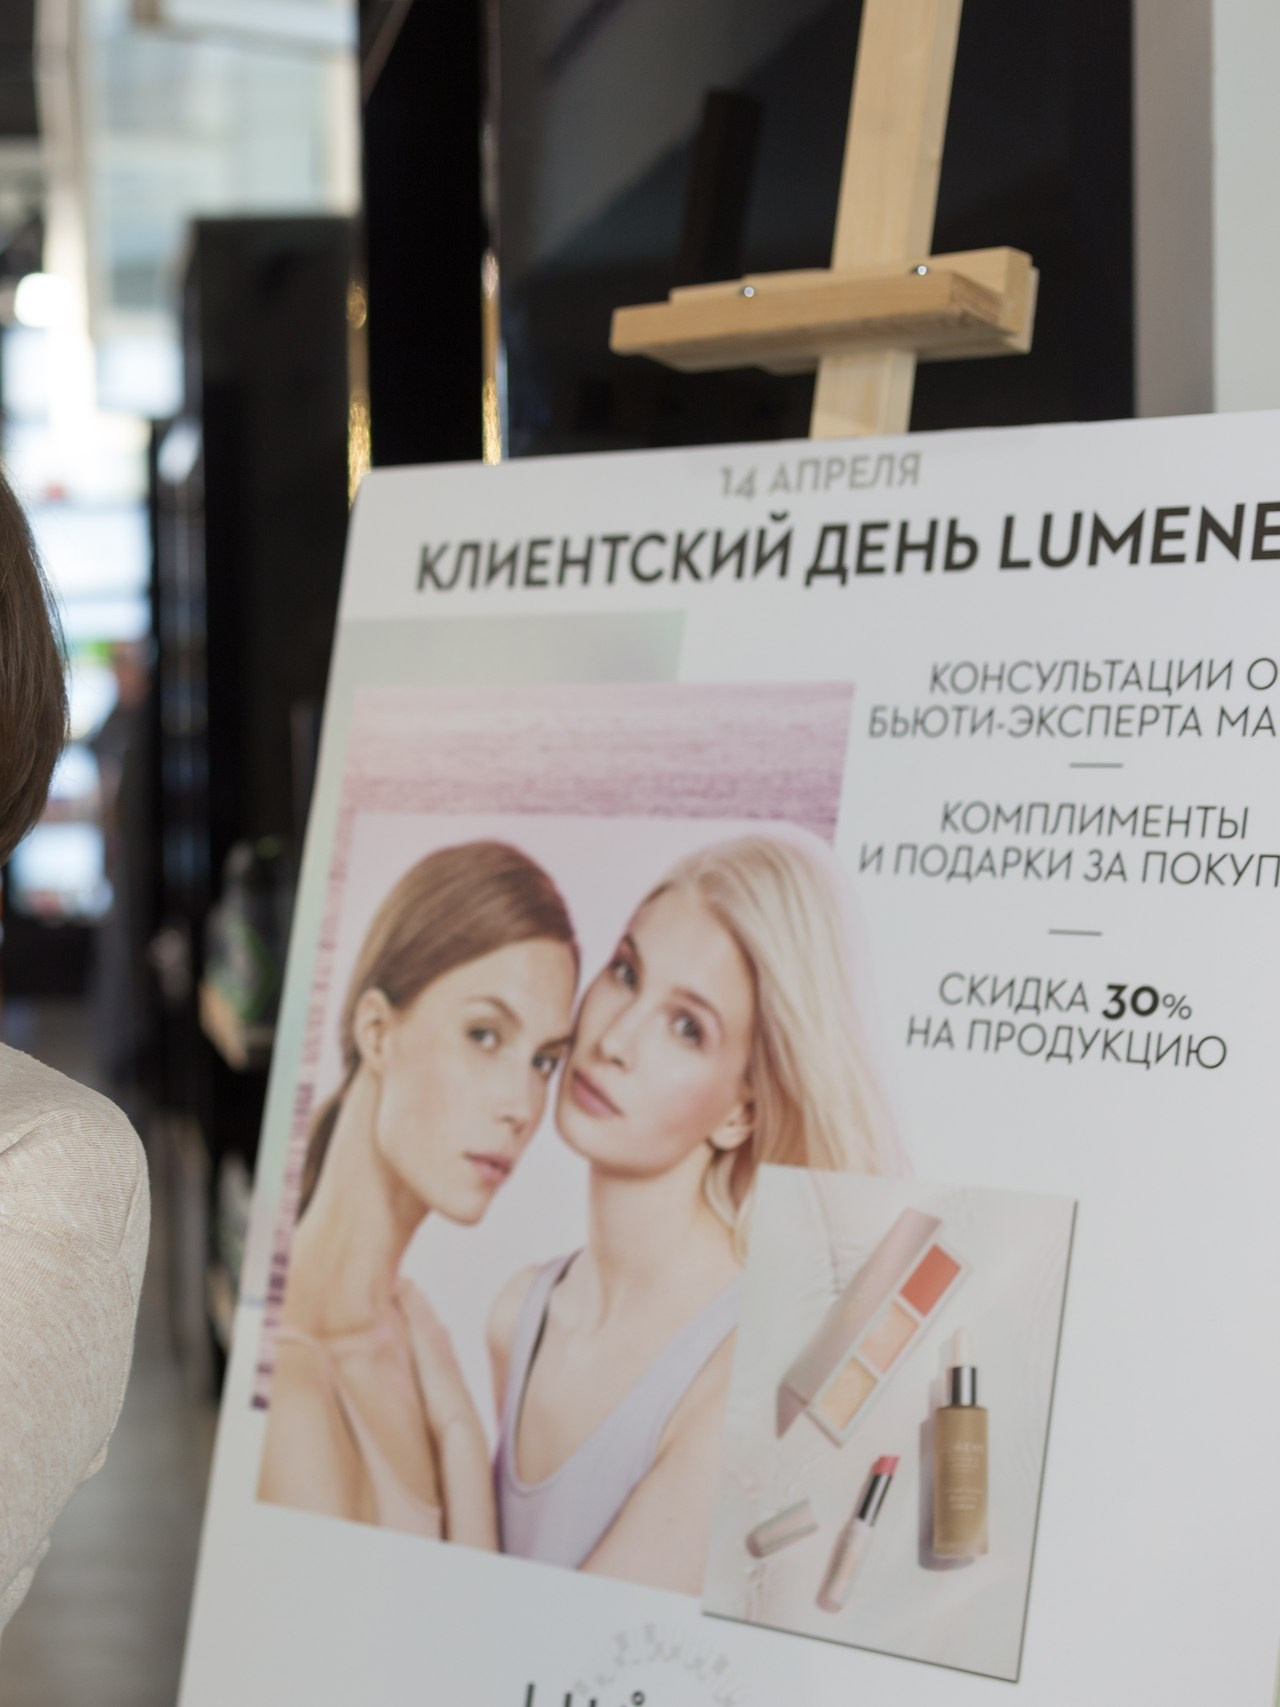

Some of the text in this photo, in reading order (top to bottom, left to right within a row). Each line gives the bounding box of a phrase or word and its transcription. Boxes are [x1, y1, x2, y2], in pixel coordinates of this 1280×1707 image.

[719, 452, 922, 501] 14 АПРЕЛЯ
[415, 501, 1280, 592] КЛИЕНТСКИЙ ДЕНЬ LUMENE
[928, 656, 1279, 697] КОНСУЛЬТАЦИИ О
[867, 703, 1277, 739] БЬЮТИ-ЭКСПЕРТА МА
[940, 800, 1249, 840] КОМПЛИМЕНТЫ
[858, 842, 1280, 888] И ПОДАРКИ ЗА ПОКУП
[938, 971, 1193, 1021] СКИДКА 30%
[905, 1014, 1228, 1071] НА ПРОДУКЦИЮ
